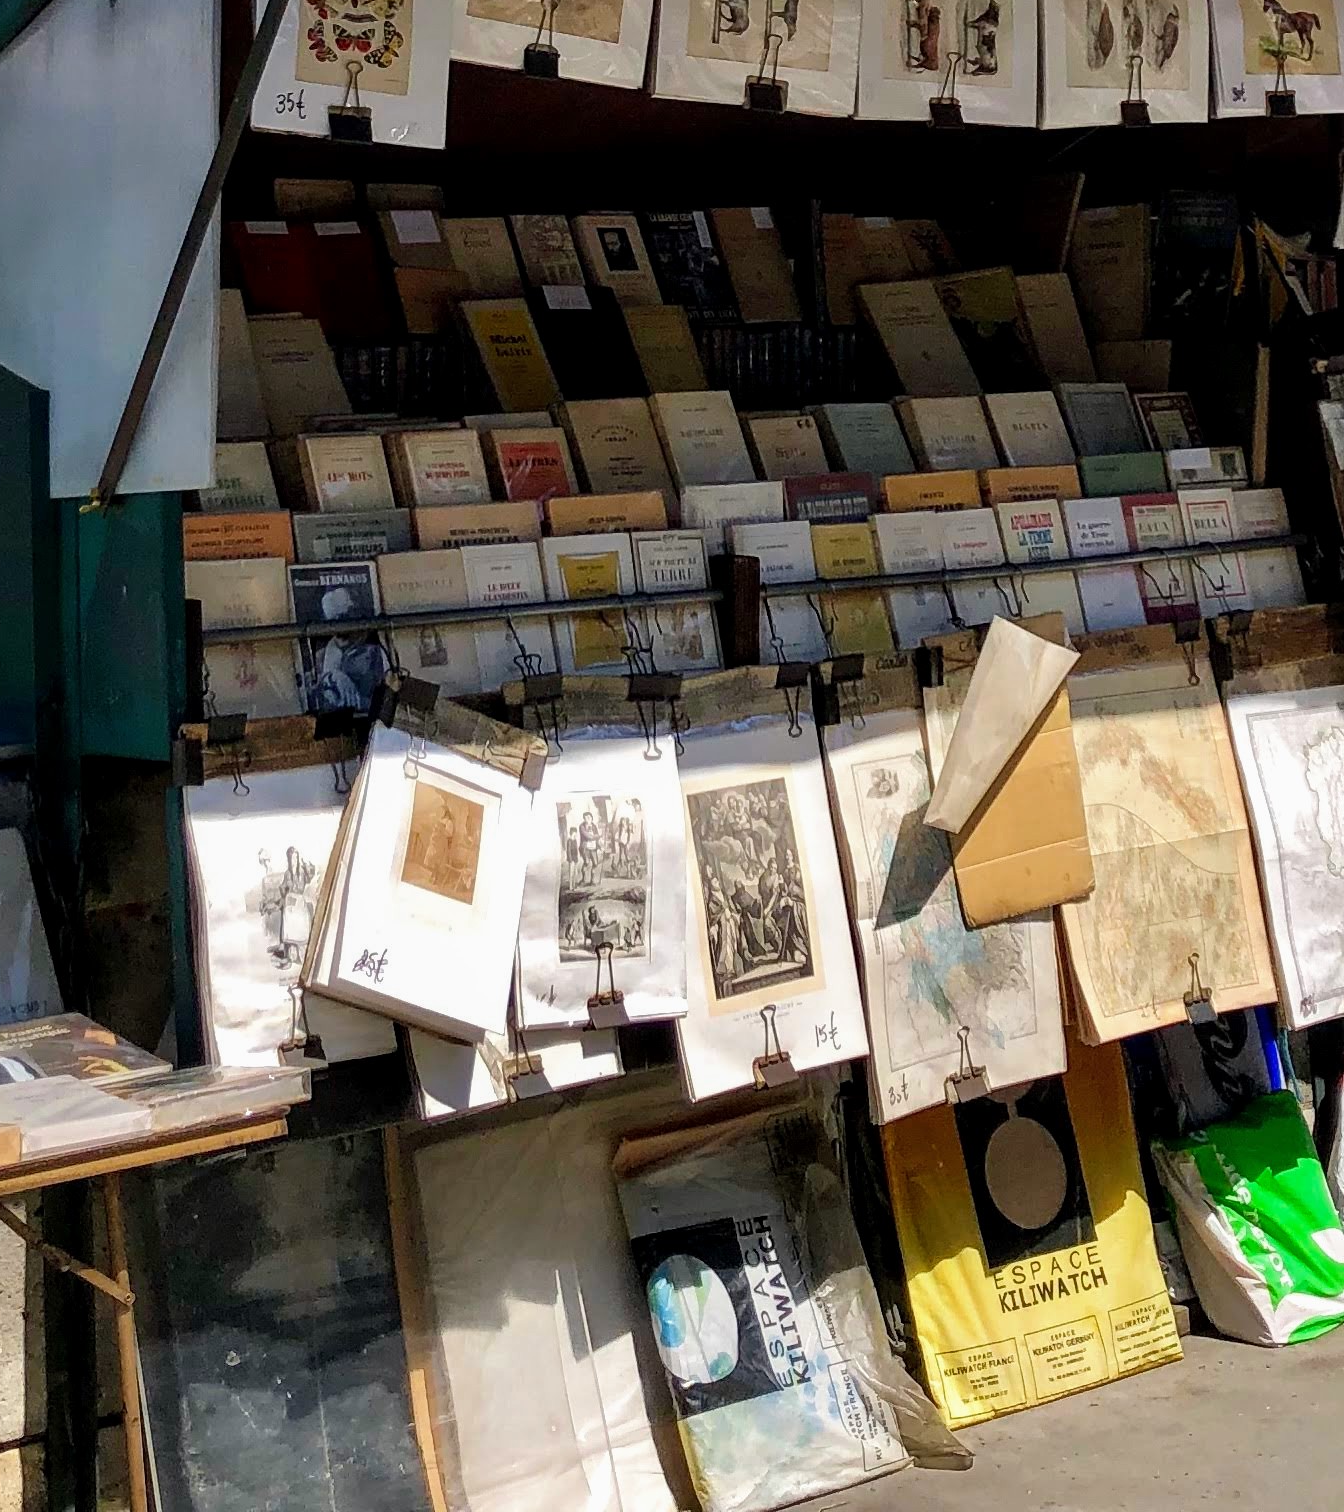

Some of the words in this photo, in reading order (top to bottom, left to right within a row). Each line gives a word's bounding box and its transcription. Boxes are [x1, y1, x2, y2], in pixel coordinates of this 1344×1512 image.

[275, 88, 307, 120] 35€
[320, 573, 369, 586] BERNANOS
[814, 1011, 842, 1050] 15€
[993, 1245, 1103, 1290] ESPACE
[736, 1219, 794, 1388] ESPACE
[754, 1215, 811, 1384] KILIWATCH
[998, 1266, 1109, 1314] KILIWATCH
[943, 1358, 988, 1377] KILIWATCH
